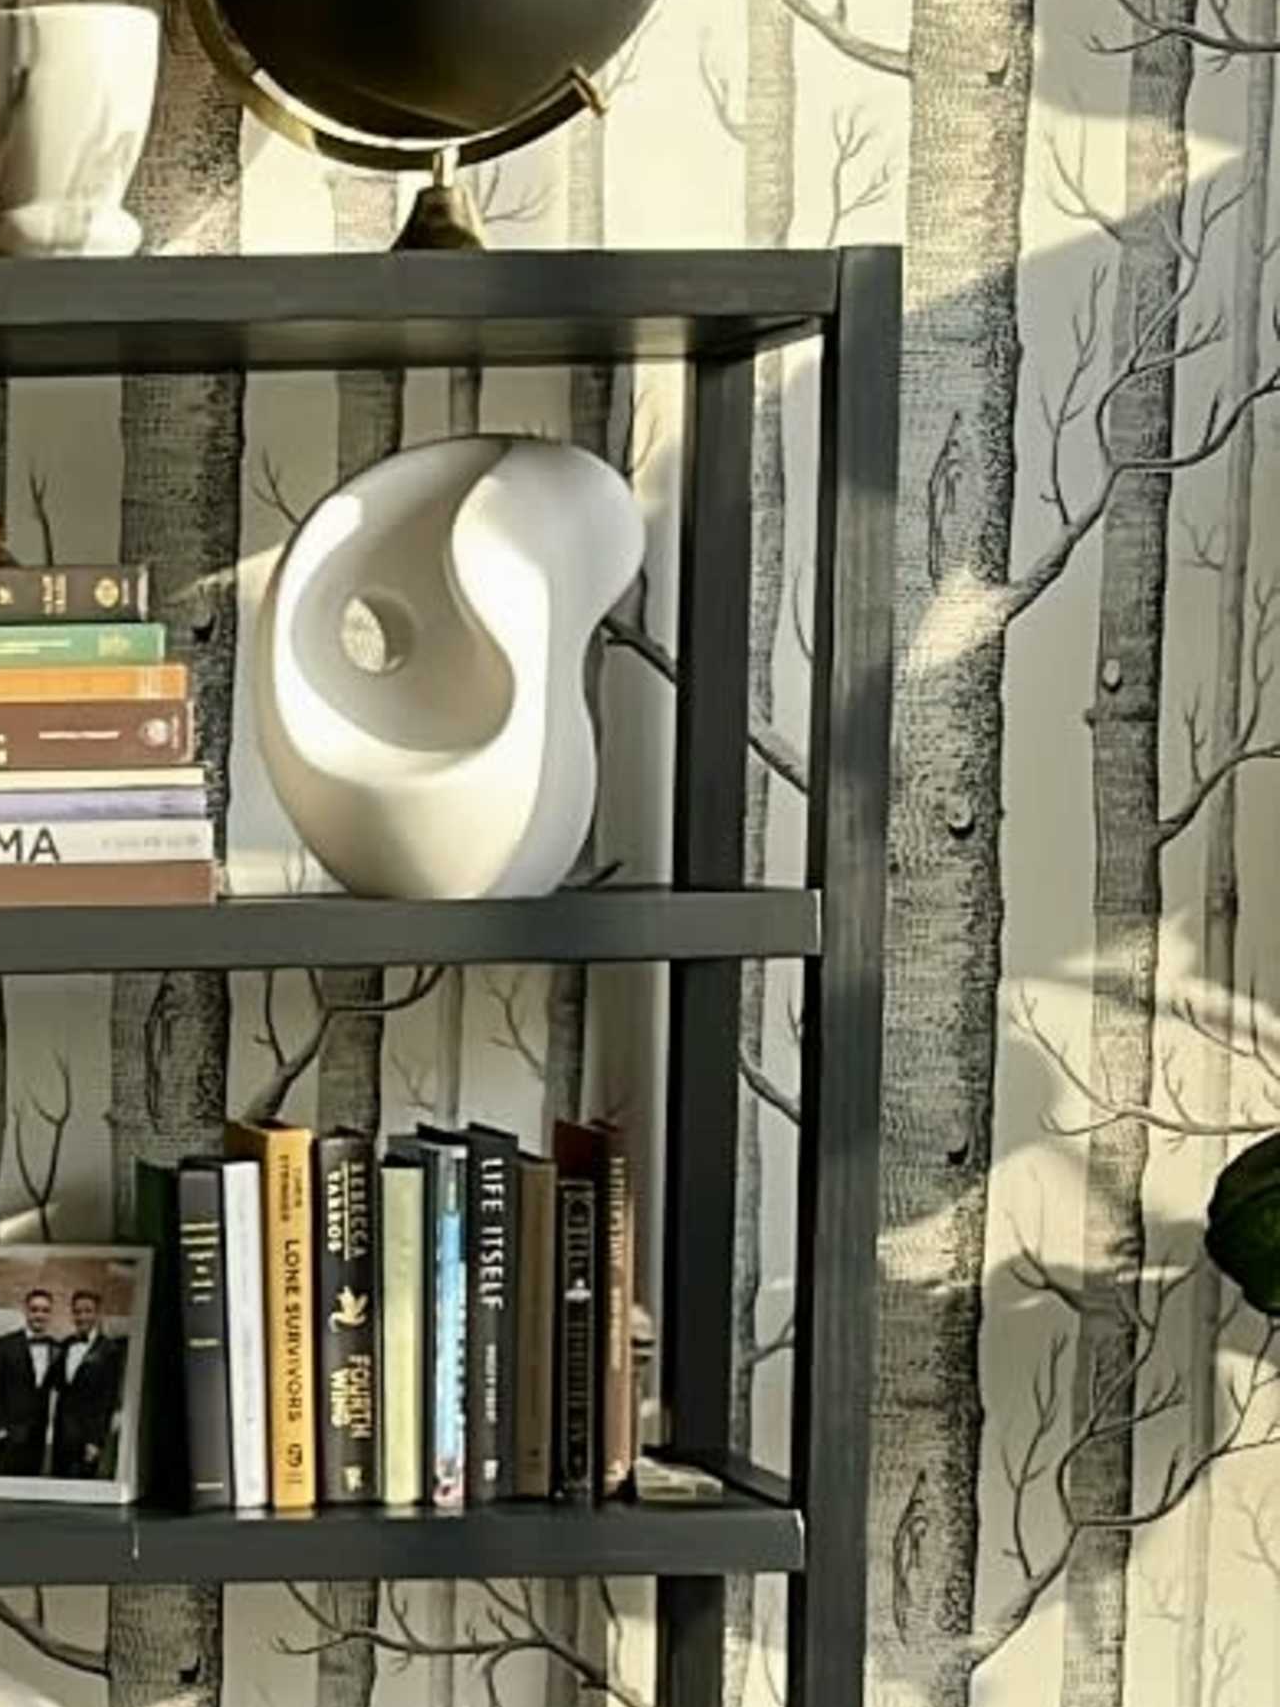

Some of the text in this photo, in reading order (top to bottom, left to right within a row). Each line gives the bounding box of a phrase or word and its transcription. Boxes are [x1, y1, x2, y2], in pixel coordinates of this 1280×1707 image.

[480, 1158, 504, 1310] LIFE ITSELF
[284, 1239, 303, 1422] LONE SURVIVORS
[328, 1370, 350, 1429] WING
[349, 1354, 372, 1440] FOURTH
